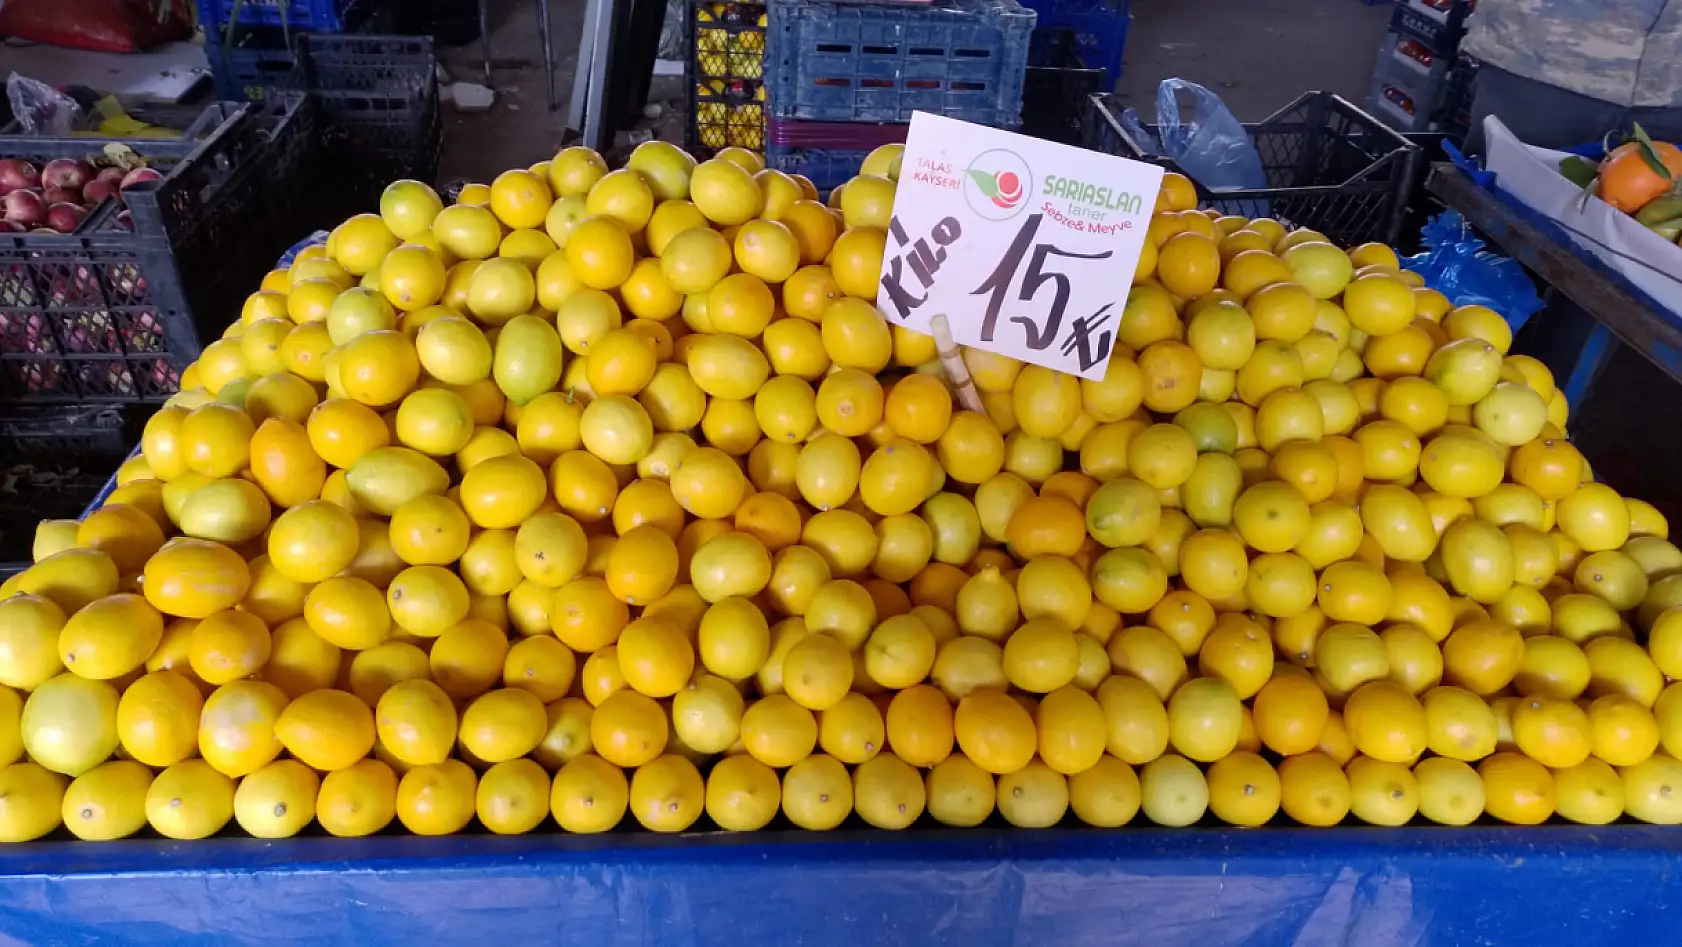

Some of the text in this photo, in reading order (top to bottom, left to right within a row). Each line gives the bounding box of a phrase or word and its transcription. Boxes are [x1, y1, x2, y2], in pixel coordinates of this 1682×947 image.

[917, 157, 952, 174] TALAS
[1068, 202, 1108, 221] taner
[1087, 220, 1132, 236] Meyve
